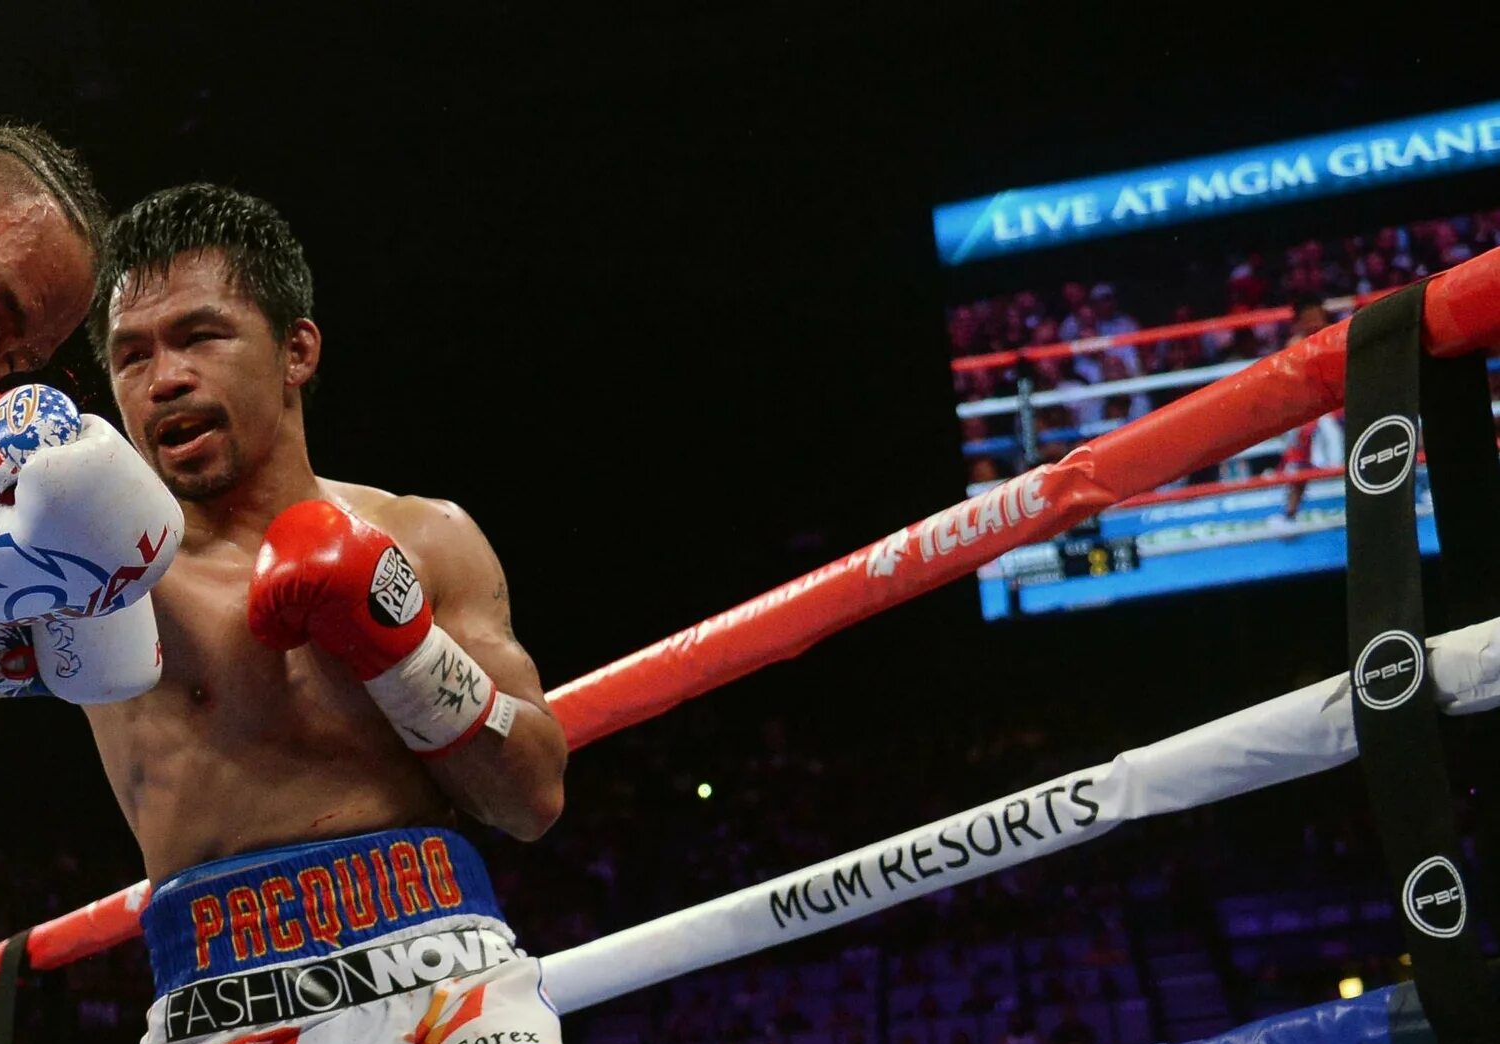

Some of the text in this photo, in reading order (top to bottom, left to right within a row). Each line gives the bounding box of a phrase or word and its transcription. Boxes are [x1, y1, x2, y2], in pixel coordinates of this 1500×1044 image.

[993, 118, 1500, 242] LIVE AT MGM GRAND
[1360, 440, 1409, 470] PBC
[917, 472, 1050, 563] TECATE
[1364, 658, 1414, 685] PBC
[770, 778, 1100, 928] MGM RESORTS
[191, 837, 462, 970] PACQUIAO
[1416, 888, 1460, 912] PBC
